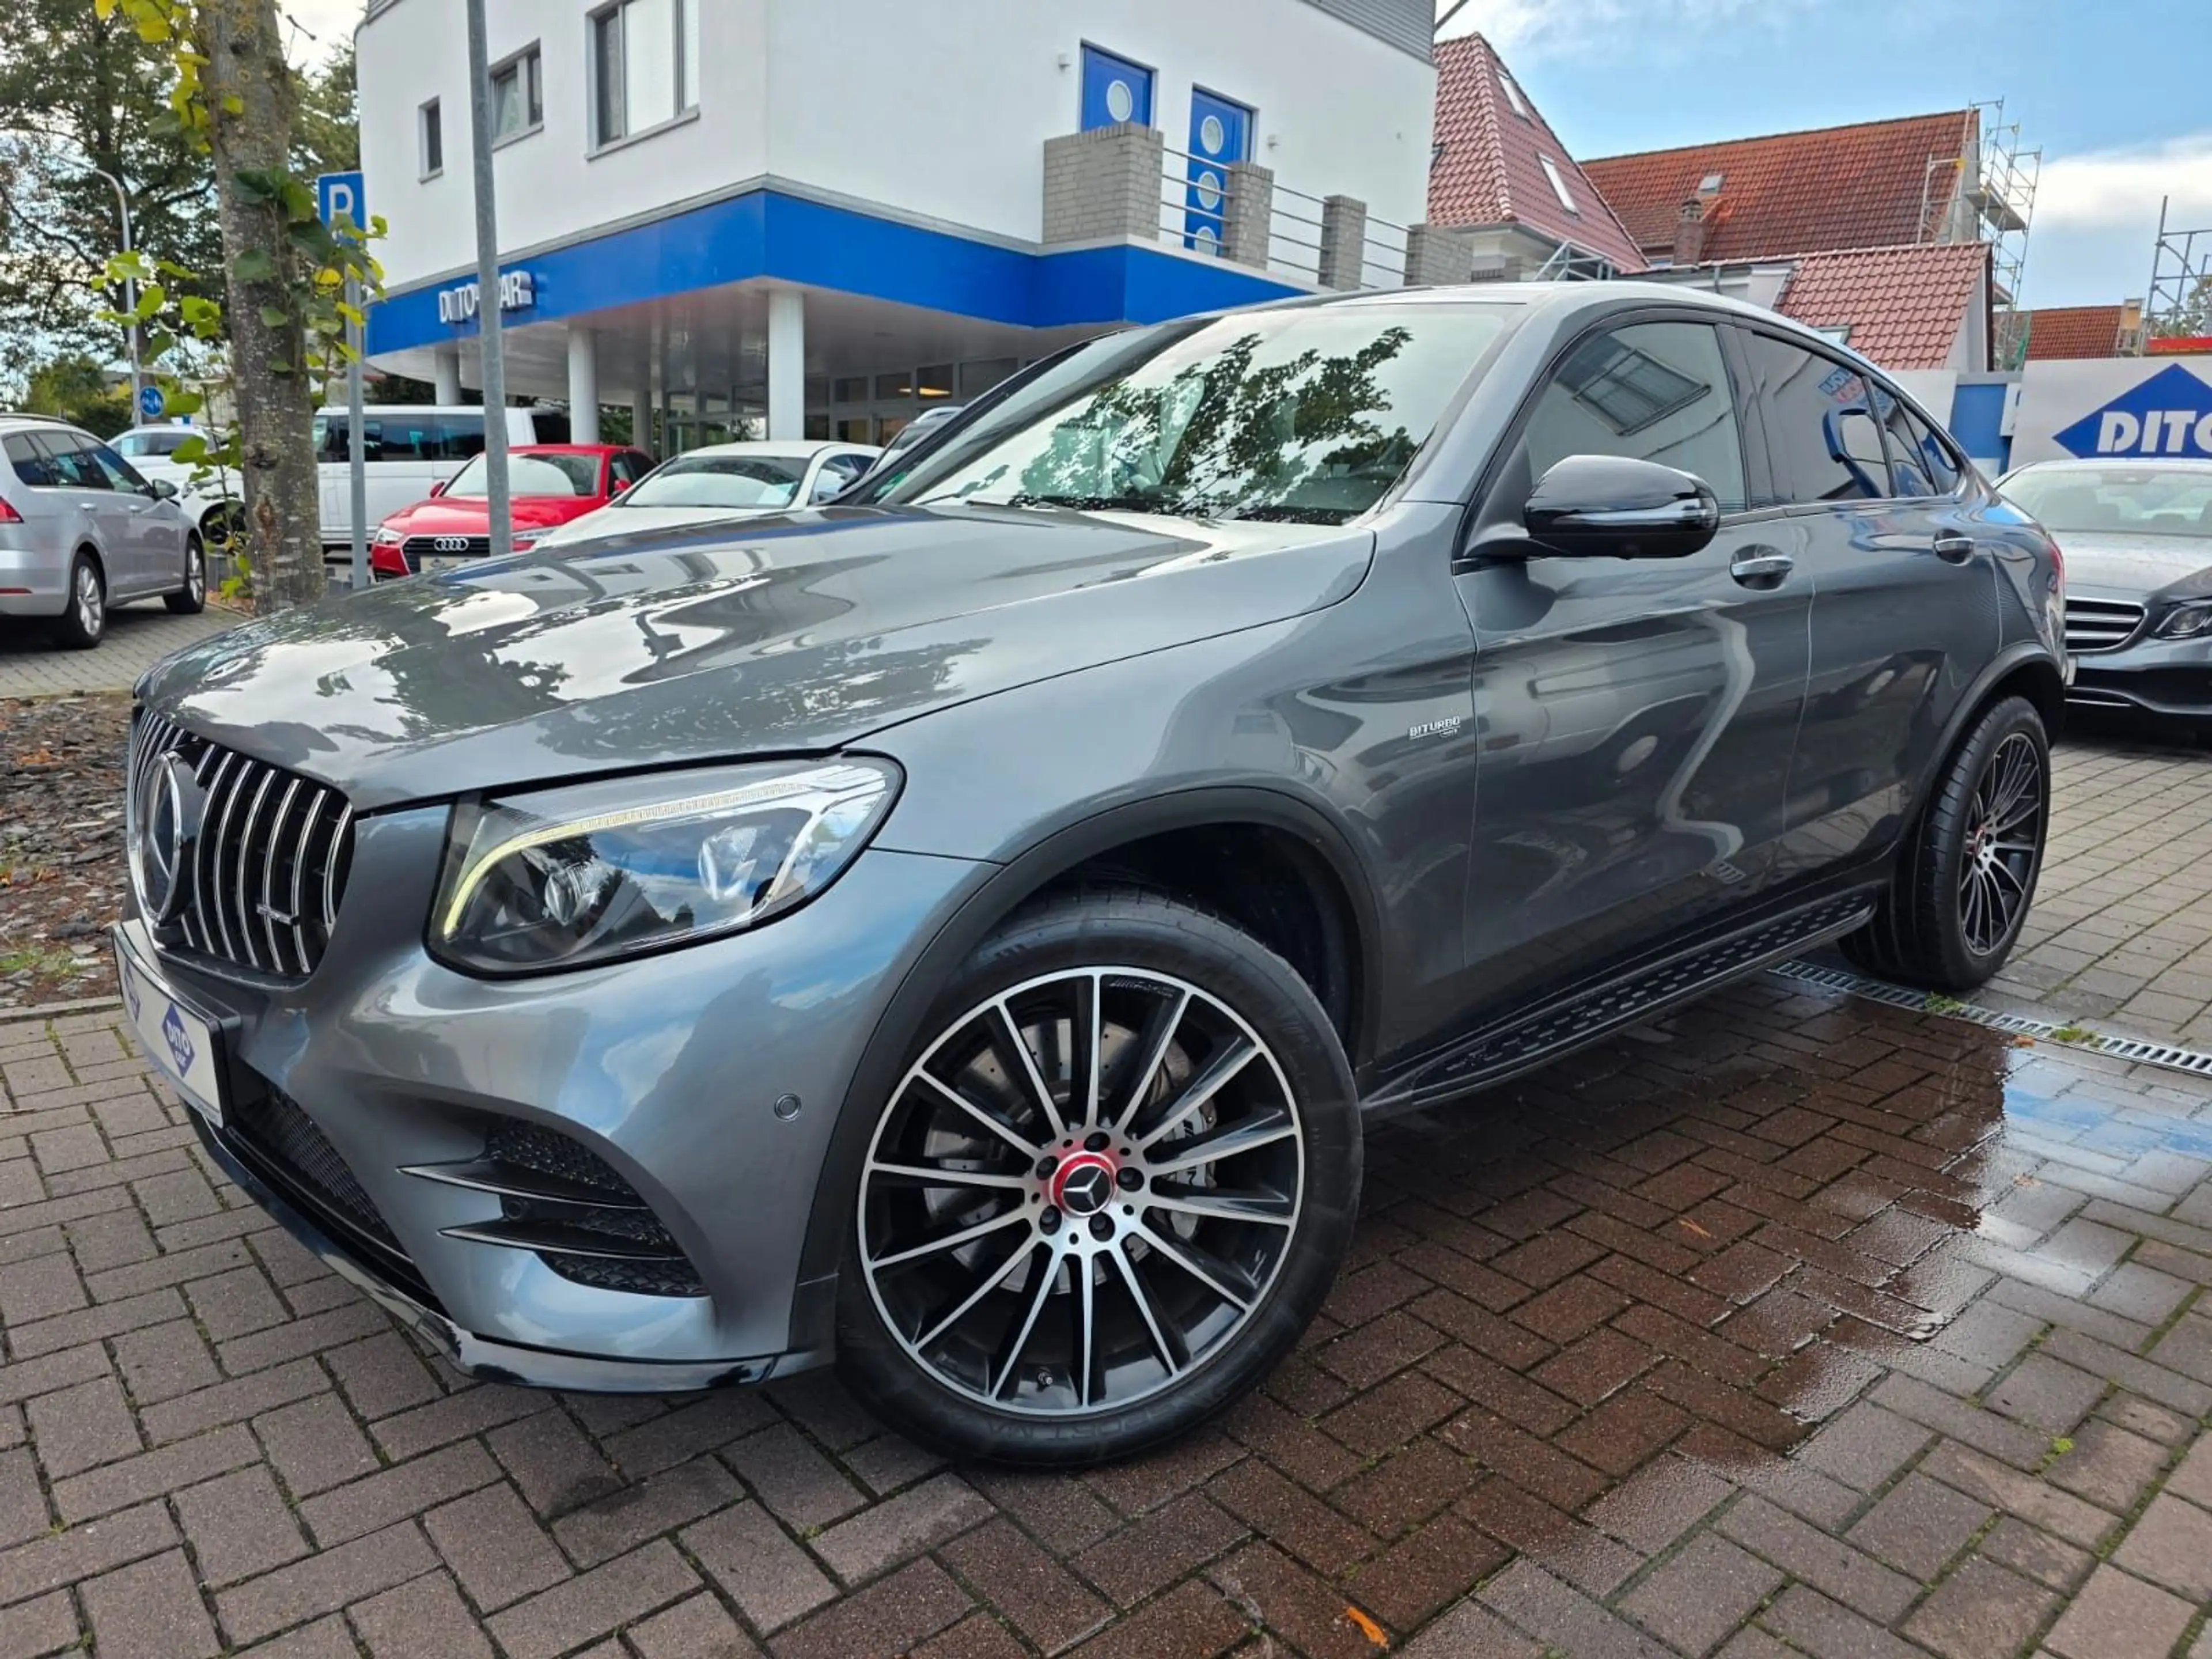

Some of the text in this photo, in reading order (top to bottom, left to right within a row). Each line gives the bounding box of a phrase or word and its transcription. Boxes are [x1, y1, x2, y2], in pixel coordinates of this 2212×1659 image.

[328, 183, 354, 240] P
[439, 271, 532, 324] DITO-AR
[1410, 715, 1460, 737] BITURBO
